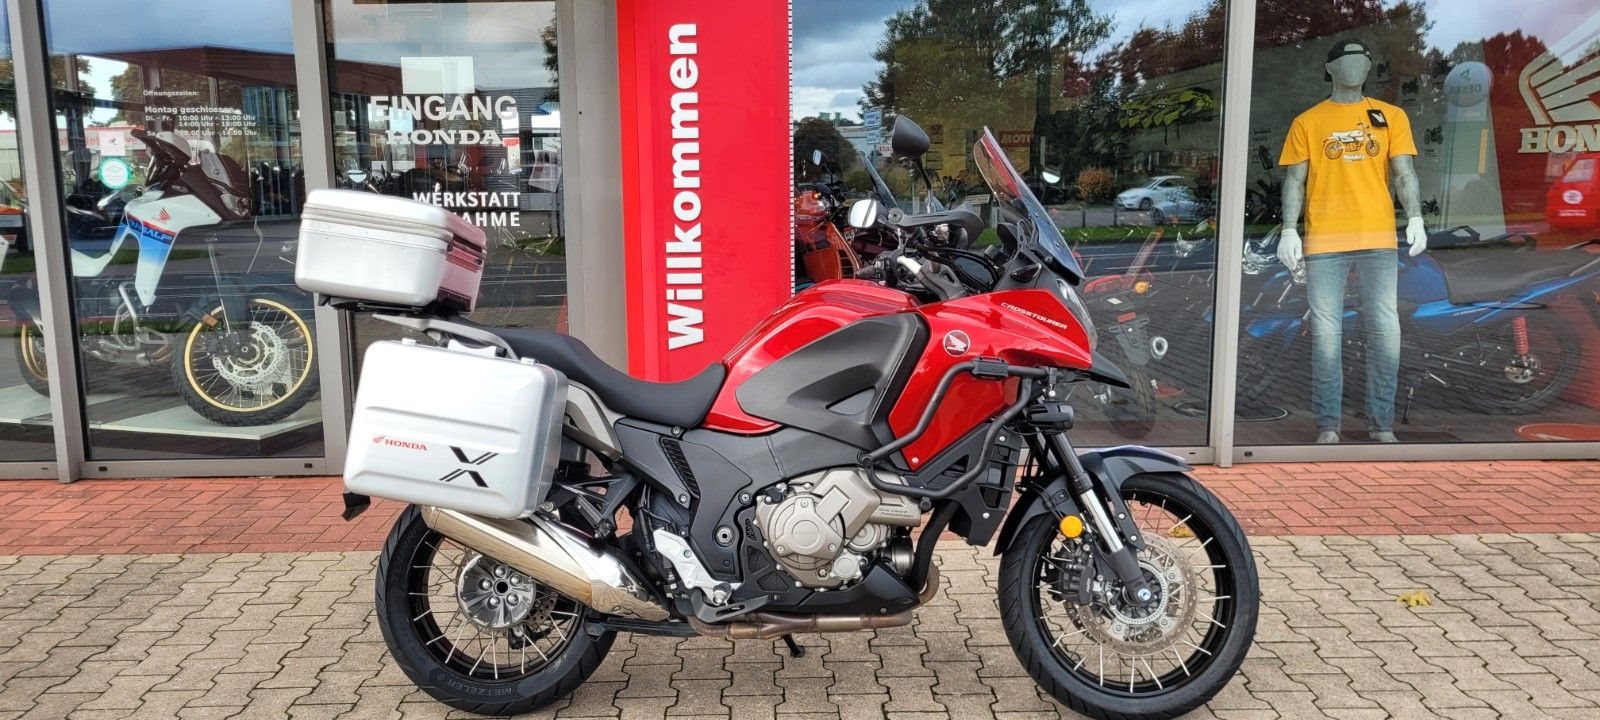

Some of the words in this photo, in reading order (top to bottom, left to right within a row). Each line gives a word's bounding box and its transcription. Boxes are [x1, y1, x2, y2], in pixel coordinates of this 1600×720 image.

[144, 106, 178, 114] Montag
[370, 95, 518, 121] EINGANG
[385, 129, 504, 145] HONDA
[665, 23, 704, 350] Willkommen
[412, 191, 521, 207] WERKSTATT
[1000, 301, 1068, 330] CROSSTOURER
[384, 438, 428, 452] HONDA
[446, 679, 512, 697] METZELER
